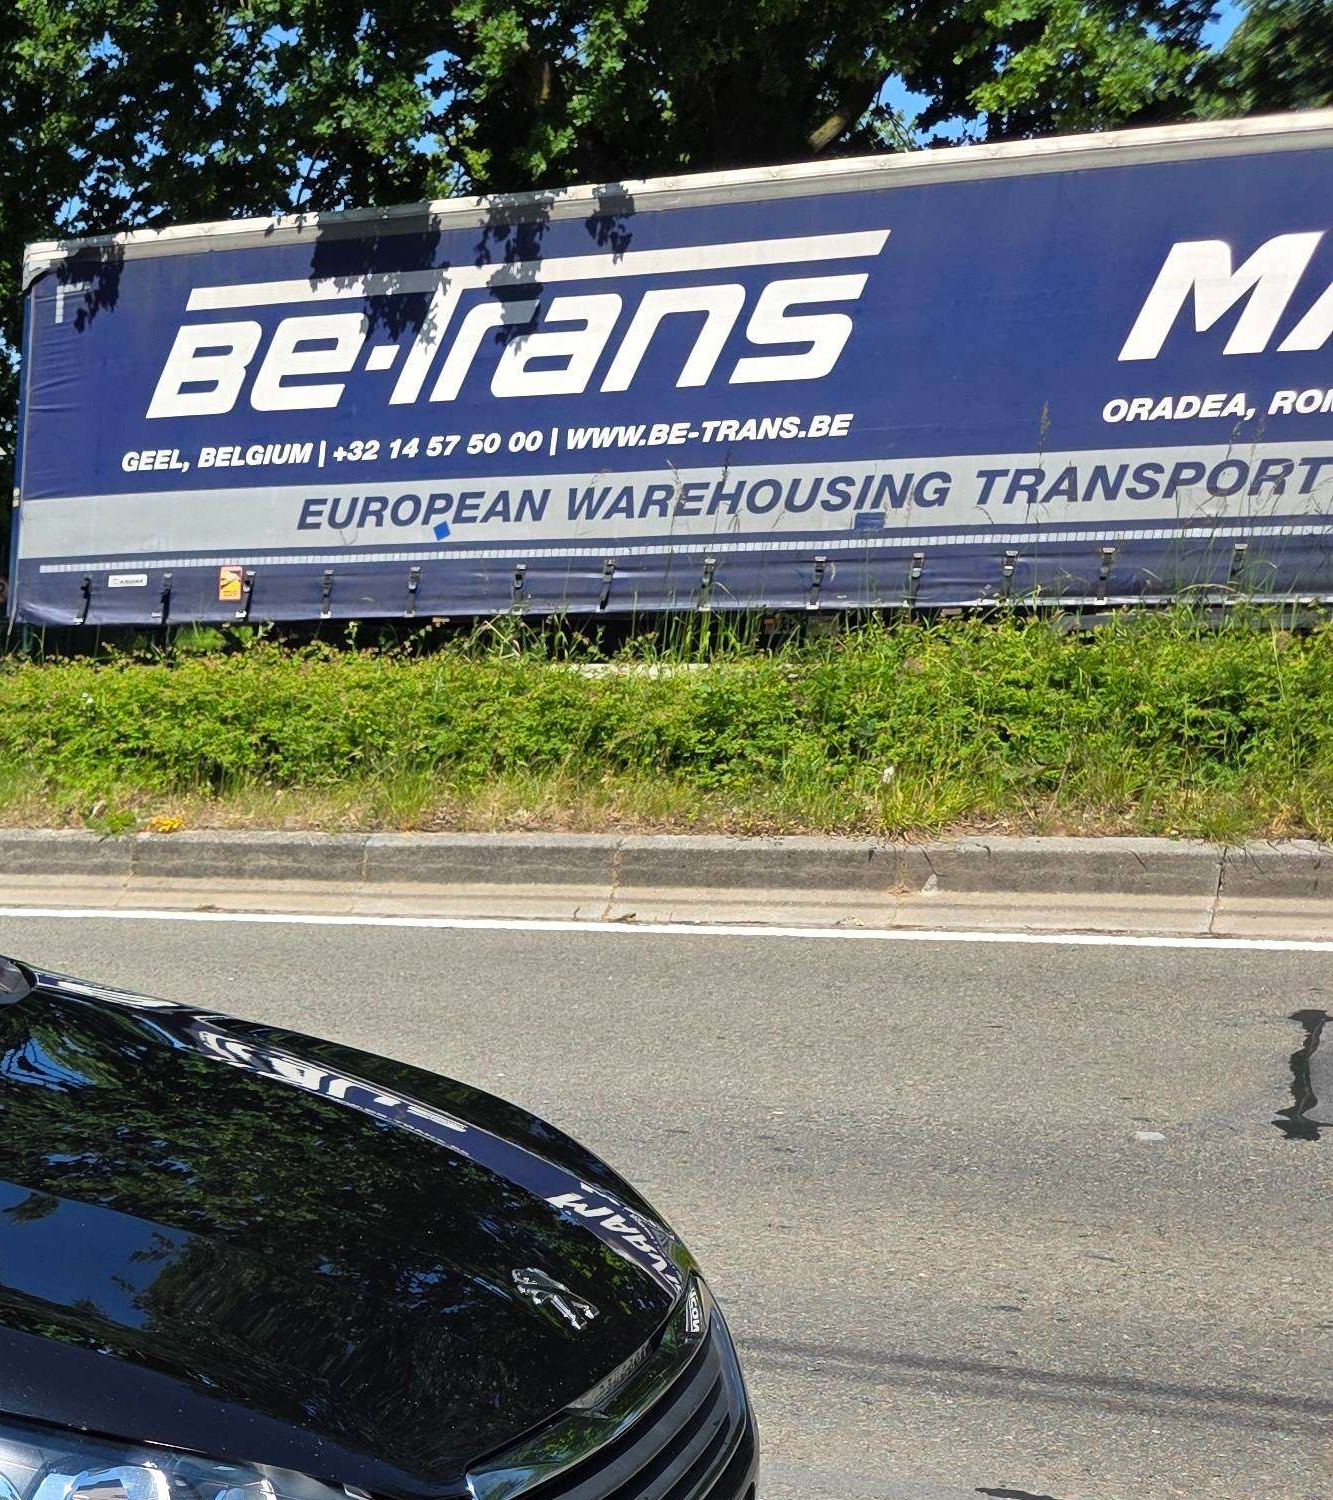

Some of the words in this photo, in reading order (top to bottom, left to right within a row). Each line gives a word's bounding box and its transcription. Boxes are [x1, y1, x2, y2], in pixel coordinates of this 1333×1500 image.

[1102, 392, 1255, 424] ORADEA,
[122, 448, 190, 473] GEEL,
[197, 442, 314, 468] BELGIUM
[333, 440, 380, 461] +32
[390, 437, 420, 459] 14
[426, 435, 461, 457] 57
[467, 432, 501, 455] 50
[508, 430, 543, 452] 00
[566, 413, 854, 450] WWW.BE-TRANS.BE
[296, 487, 552, 531] EUROPEAN
[567, 470, 953, 521] WAREHOUSING
[976, 456, 1333, 505] TRANSPORT
